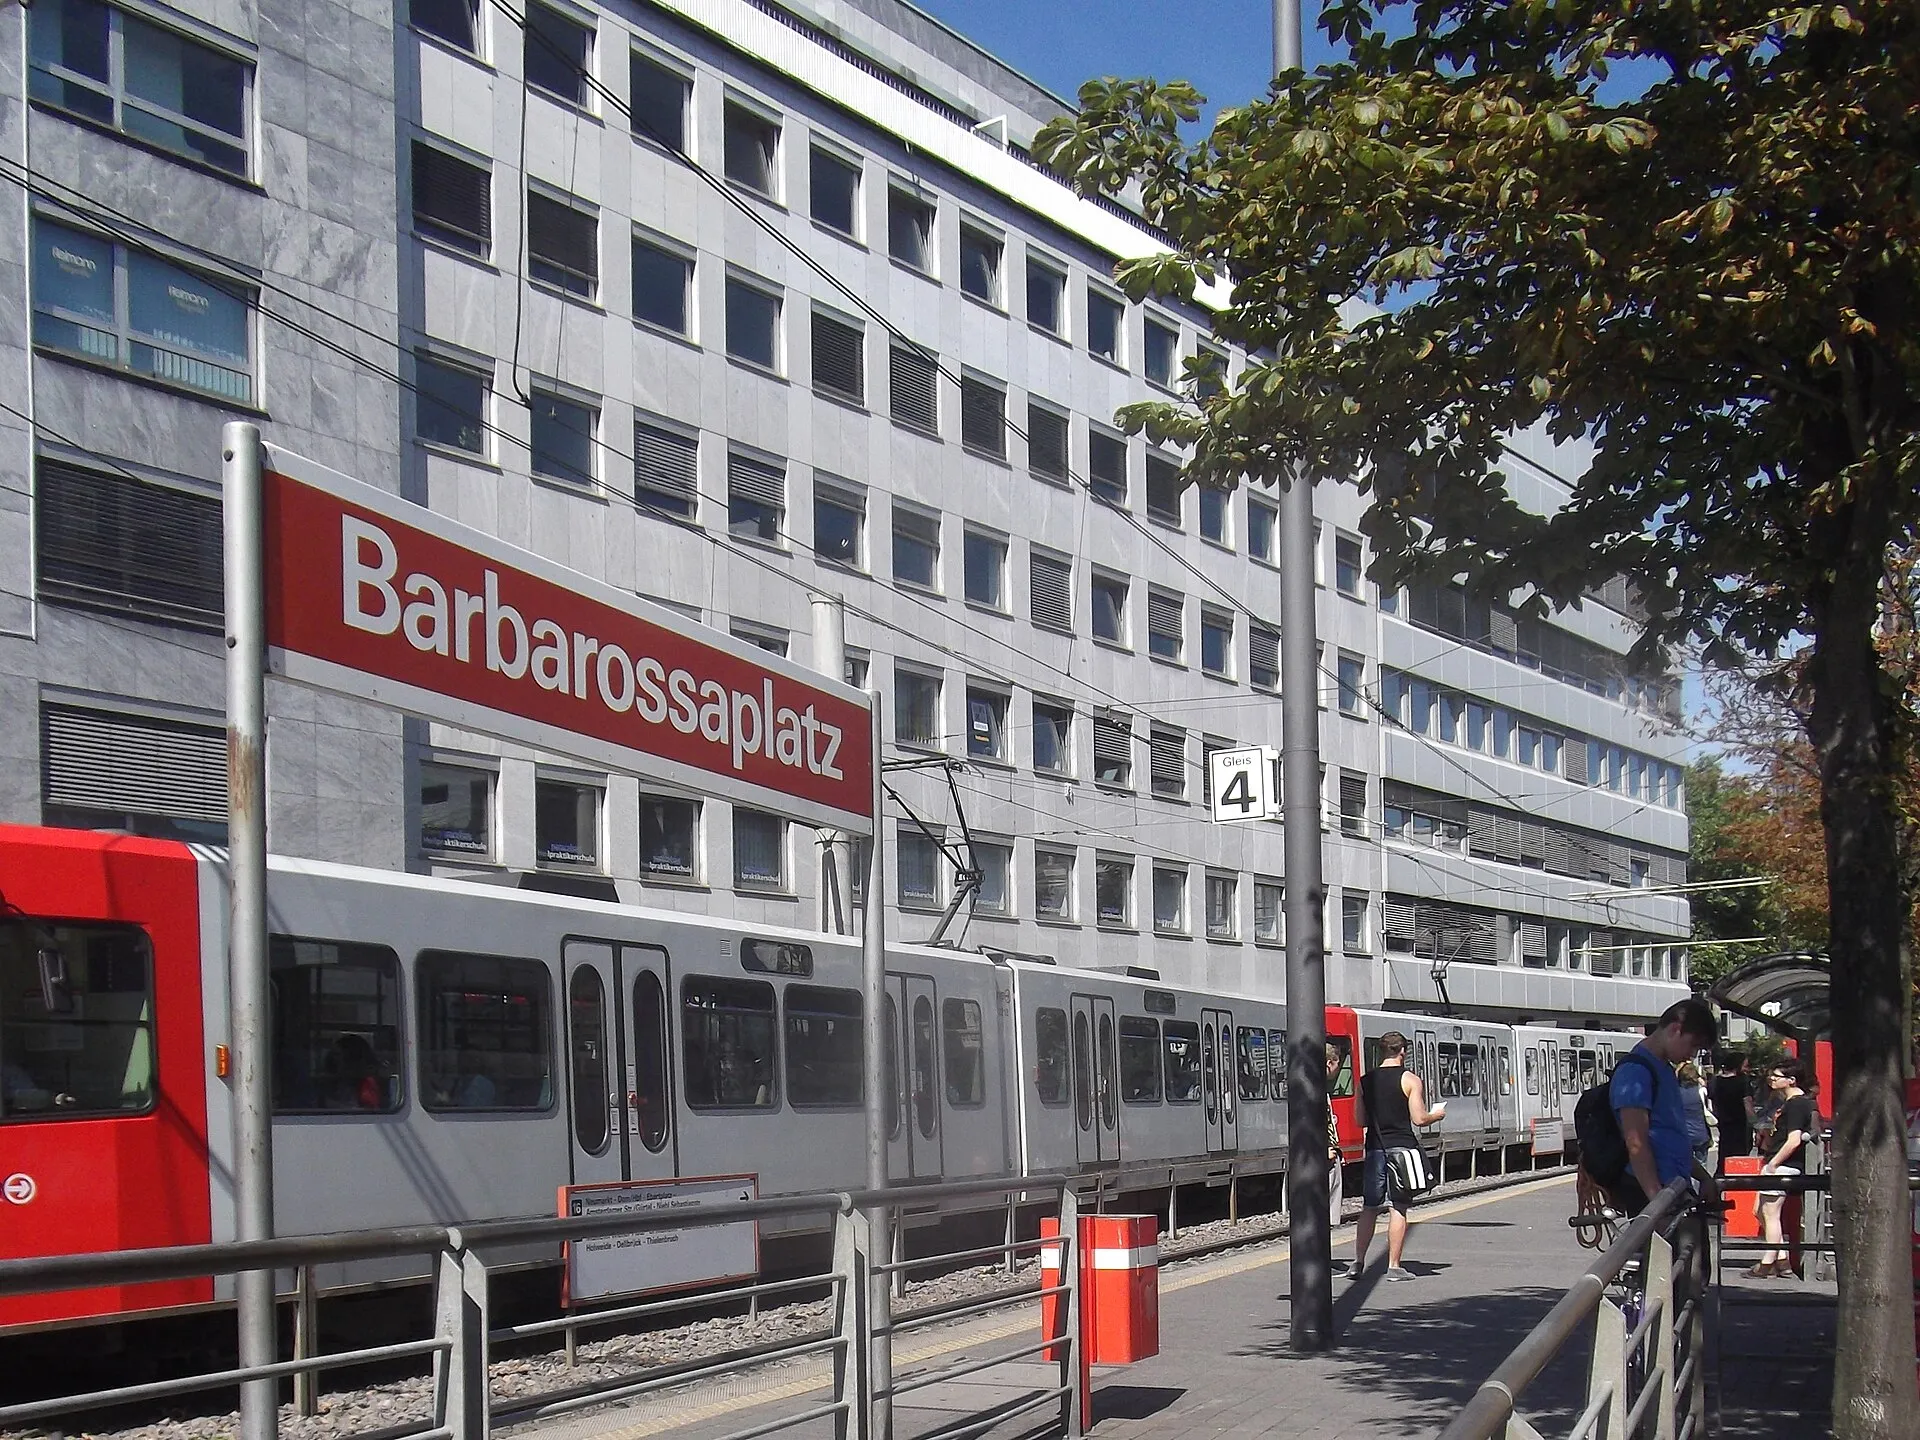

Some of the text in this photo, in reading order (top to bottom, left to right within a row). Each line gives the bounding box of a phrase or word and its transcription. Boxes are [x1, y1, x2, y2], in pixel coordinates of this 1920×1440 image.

[341, 513, 843, 782] Barbarossaplatz
[1222, 756, 1252, 767] Gleis
[1221, 770, 1257, 813] 4
